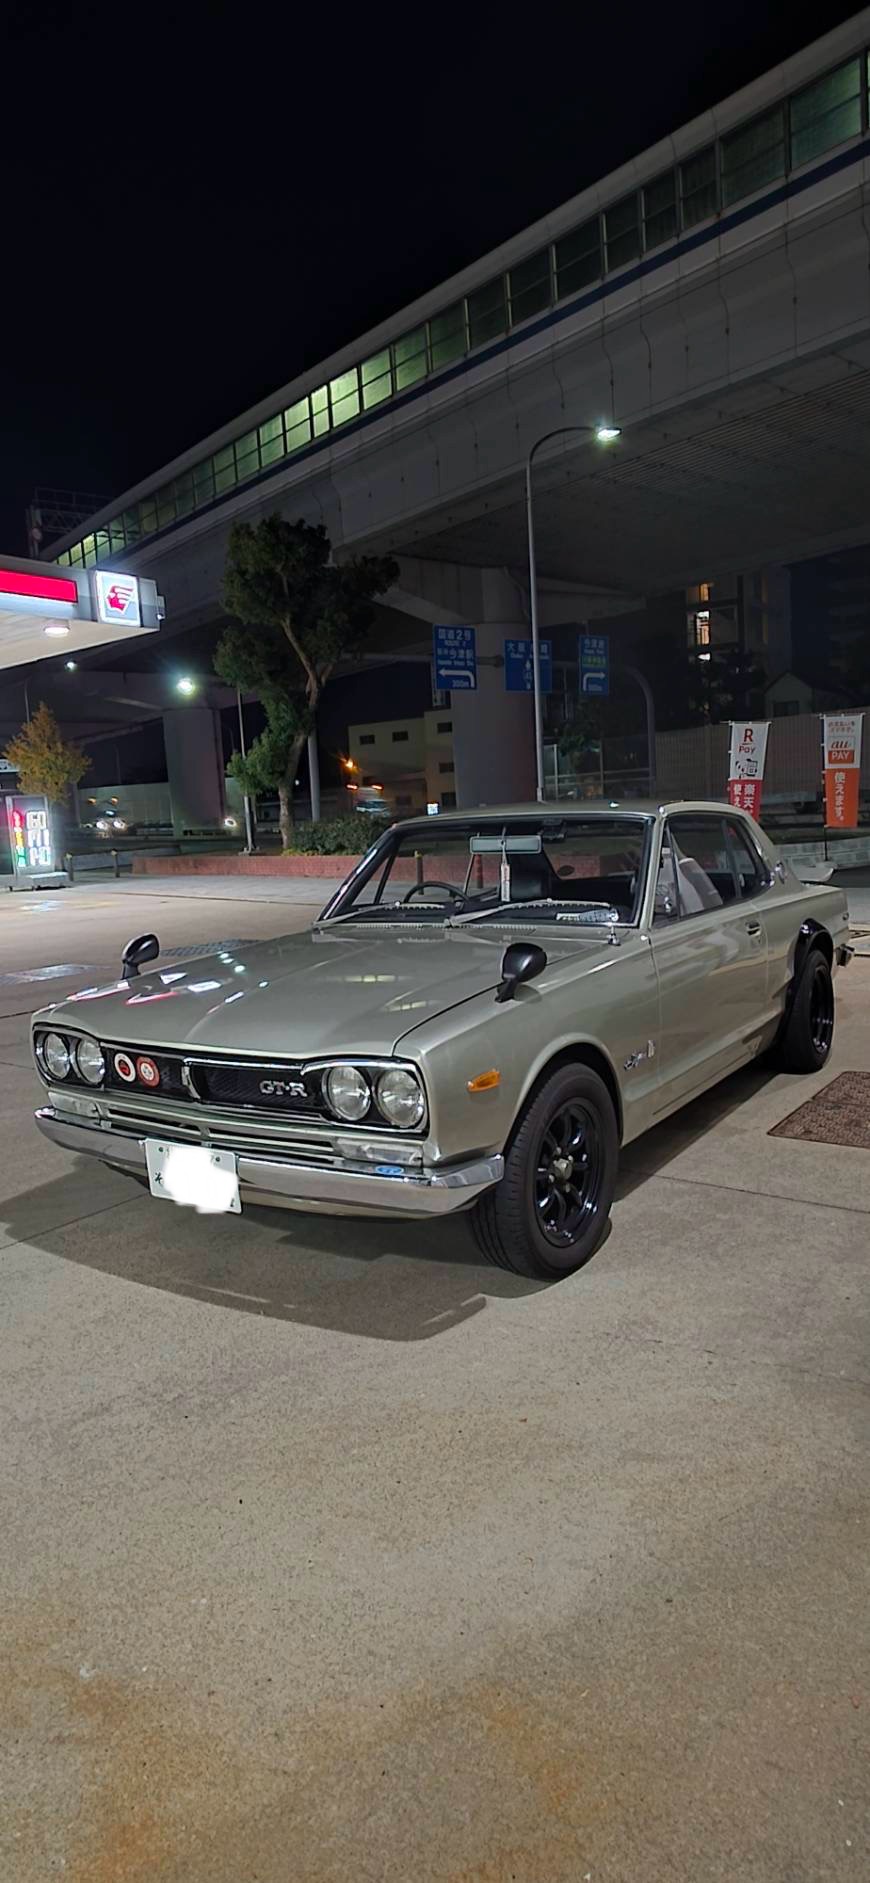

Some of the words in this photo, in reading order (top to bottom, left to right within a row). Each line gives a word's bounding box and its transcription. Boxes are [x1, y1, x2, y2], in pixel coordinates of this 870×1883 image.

[744, 728, 754, 742] R
[739, 745, 757, 755] Pay
[831, 740, 850, 750] au
[831, 751, 851, 761] PAY
[834, 771, 846, 822] 使えます。
